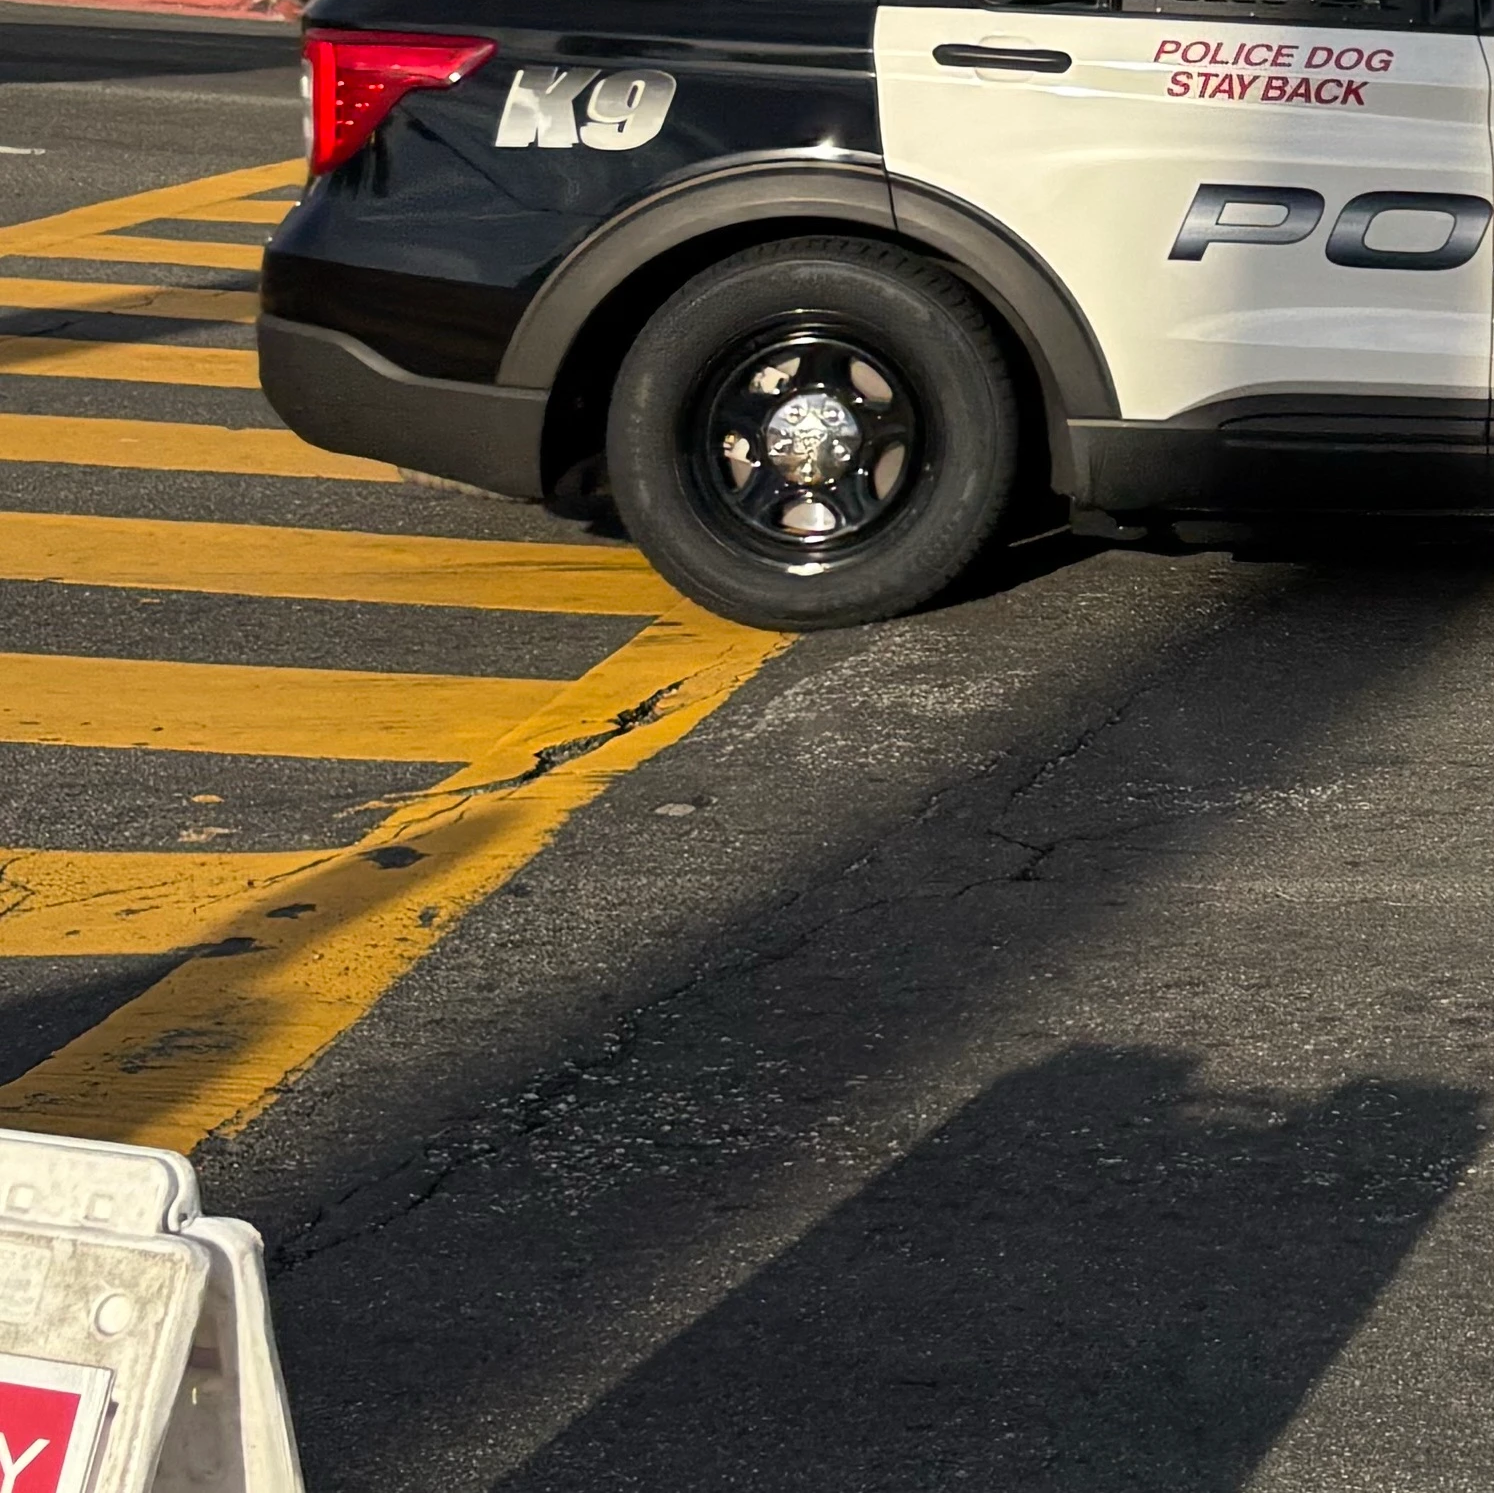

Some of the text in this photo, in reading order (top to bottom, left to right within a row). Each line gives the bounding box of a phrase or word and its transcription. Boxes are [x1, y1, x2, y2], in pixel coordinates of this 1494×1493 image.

[1153, 39, 1395, 72] POLICE DOG
[1167, 71, 1369, 106] STAY BACK
[495, 65, 677, 151] K9
